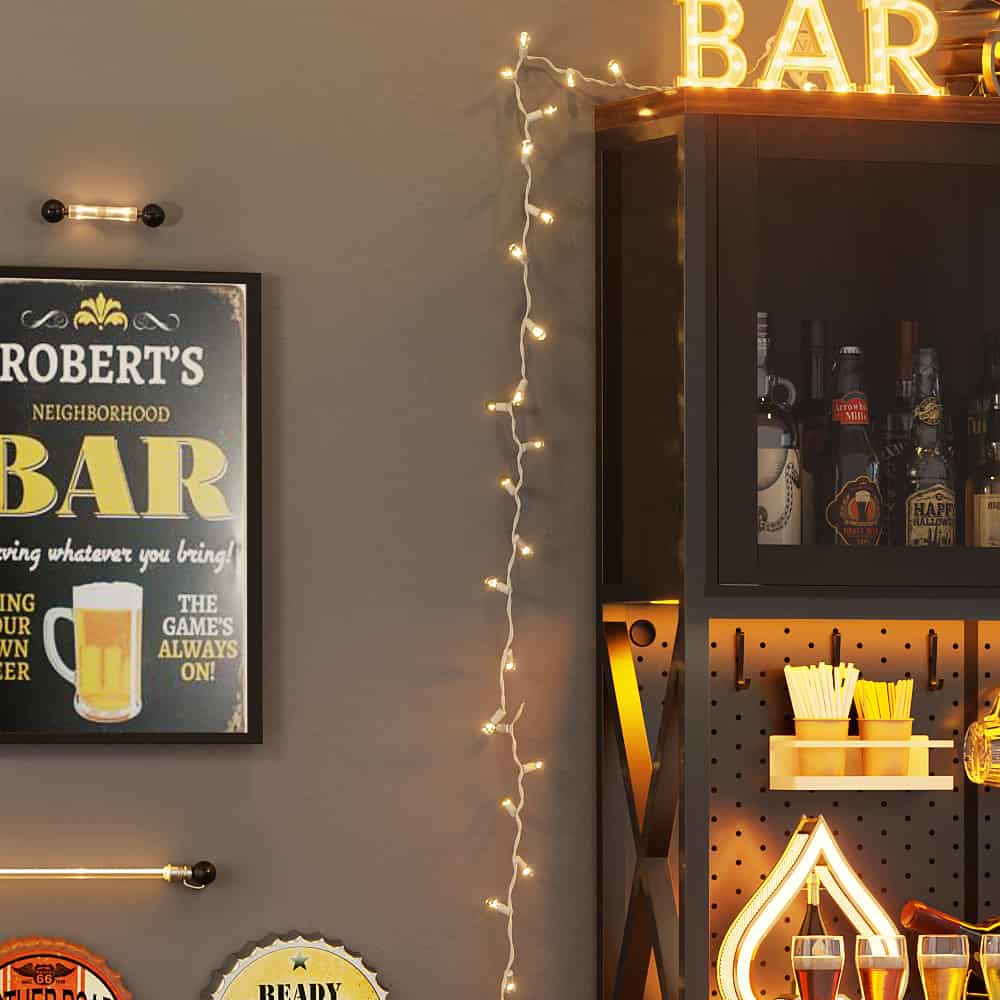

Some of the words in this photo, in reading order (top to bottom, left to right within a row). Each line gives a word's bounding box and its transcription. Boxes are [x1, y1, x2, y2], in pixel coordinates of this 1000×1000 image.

[674, 0, 950, 96] BAR
[0, 343, 205, 386] ROBERT'S
[32, 403, 170, 422] NEIGHBORHOOD
[0, 433, 235, 520] BAR
[48, 538, 132, 563] whatever
[139, 549, 170, 573] you
[177, 539, 235, 573] bring!
[0, 593, 35, 612] ING
[178, 594, 217, 613] THE
[162, 617, 233, 636] GAME'S
[158, 639, 238, 658] ALWAYS
[181, 662, 215, 681] ON!
